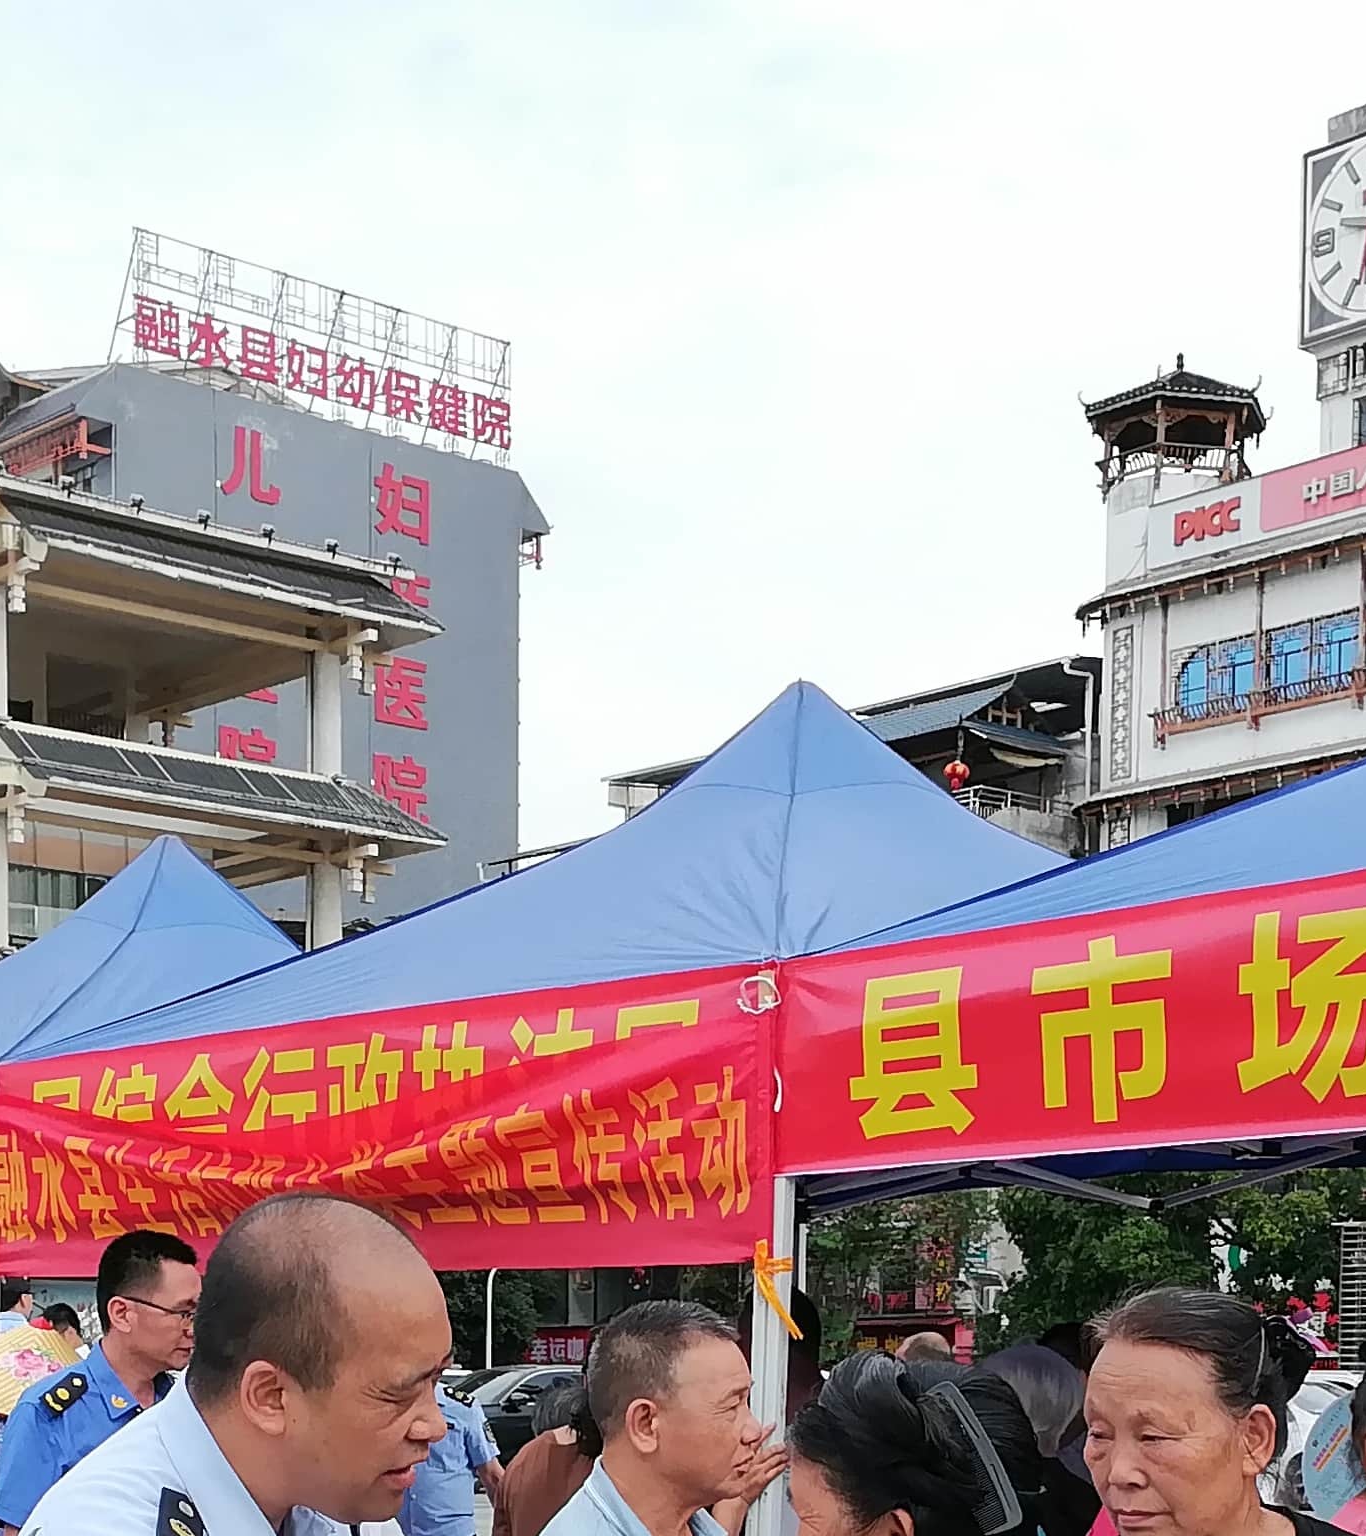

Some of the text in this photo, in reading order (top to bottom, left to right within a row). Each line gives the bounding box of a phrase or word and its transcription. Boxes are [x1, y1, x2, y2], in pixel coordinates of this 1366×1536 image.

[133, 295, 512, 450] 融水县妇幼保健院
[1173, 497, 1241, 547] PICC
